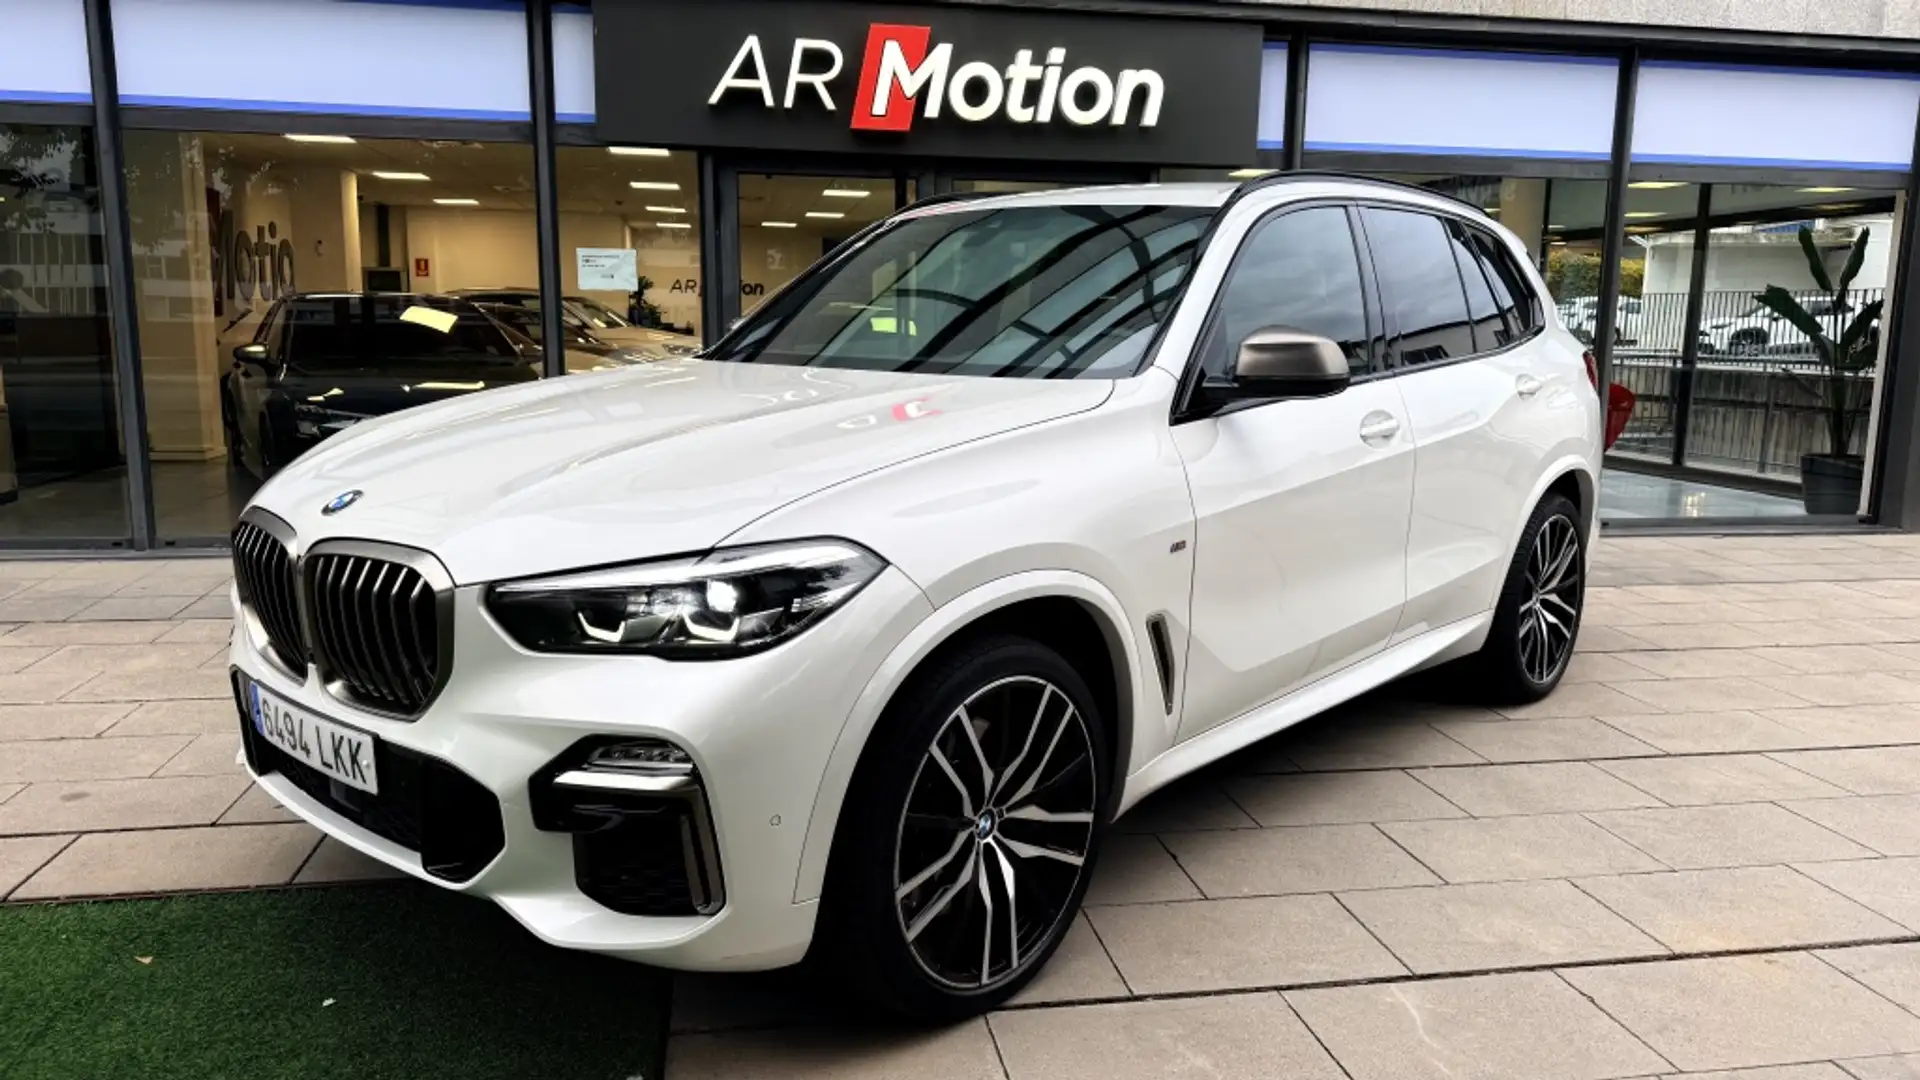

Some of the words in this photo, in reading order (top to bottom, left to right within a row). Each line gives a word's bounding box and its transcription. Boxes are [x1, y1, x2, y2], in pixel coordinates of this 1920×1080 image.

[708, 33, 844, 111] AR
[871, 38, 1165, 128] Motion
[210, 209, 296, 302] Motio
[669, 278, 697, 294] AR
[262, 697, 310, 759] 6494
[315, 724, 367, 784] LKK
